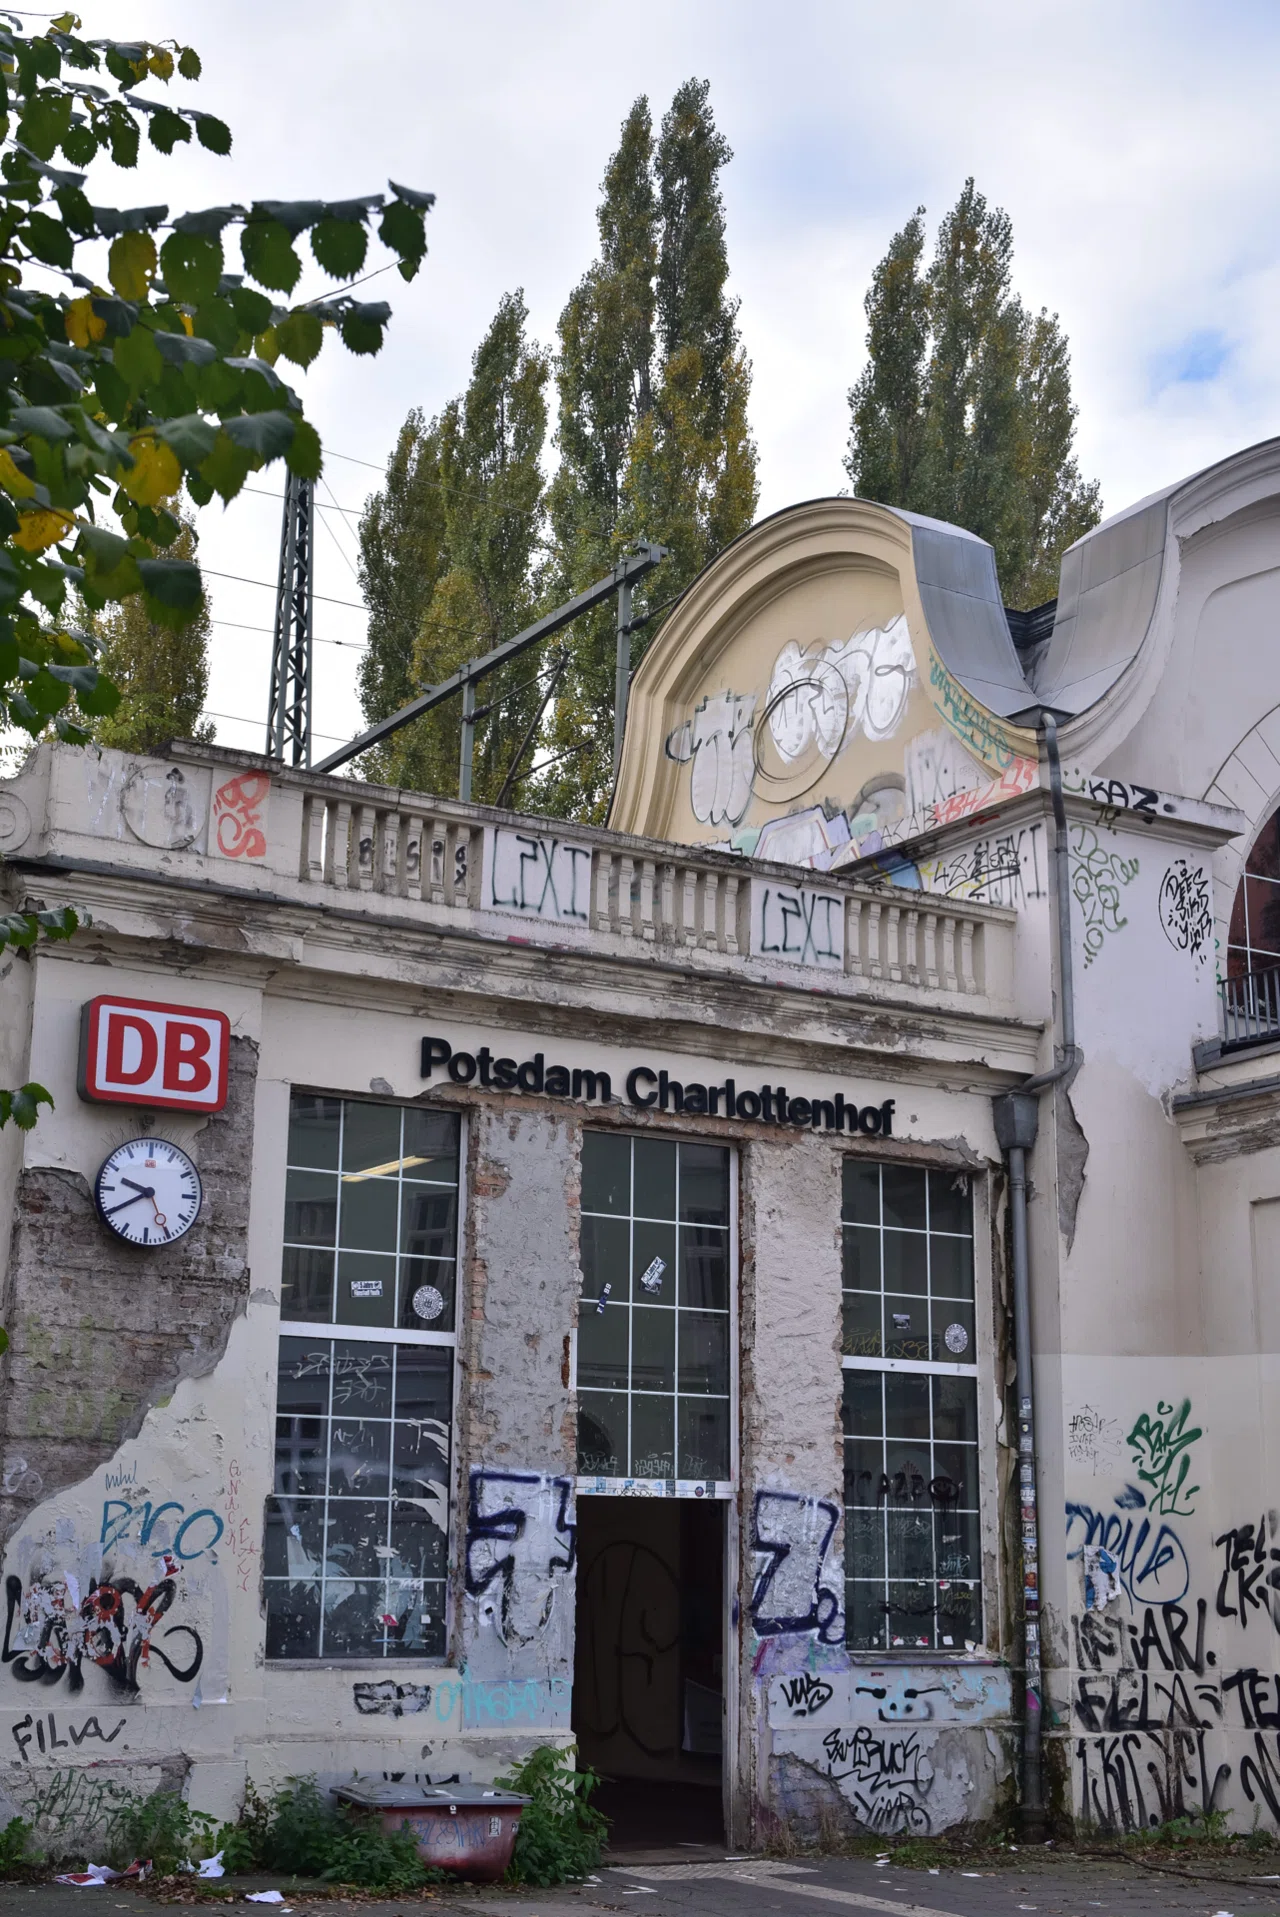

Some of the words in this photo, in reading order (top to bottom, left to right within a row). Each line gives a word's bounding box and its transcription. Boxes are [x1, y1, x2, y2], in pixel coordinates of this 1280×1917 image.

[105, 1012, 212, 1093] DB
[421, 1036, 611, 1101] Potsdam
[626, 1066, 896, 1135] Charlottenhof
